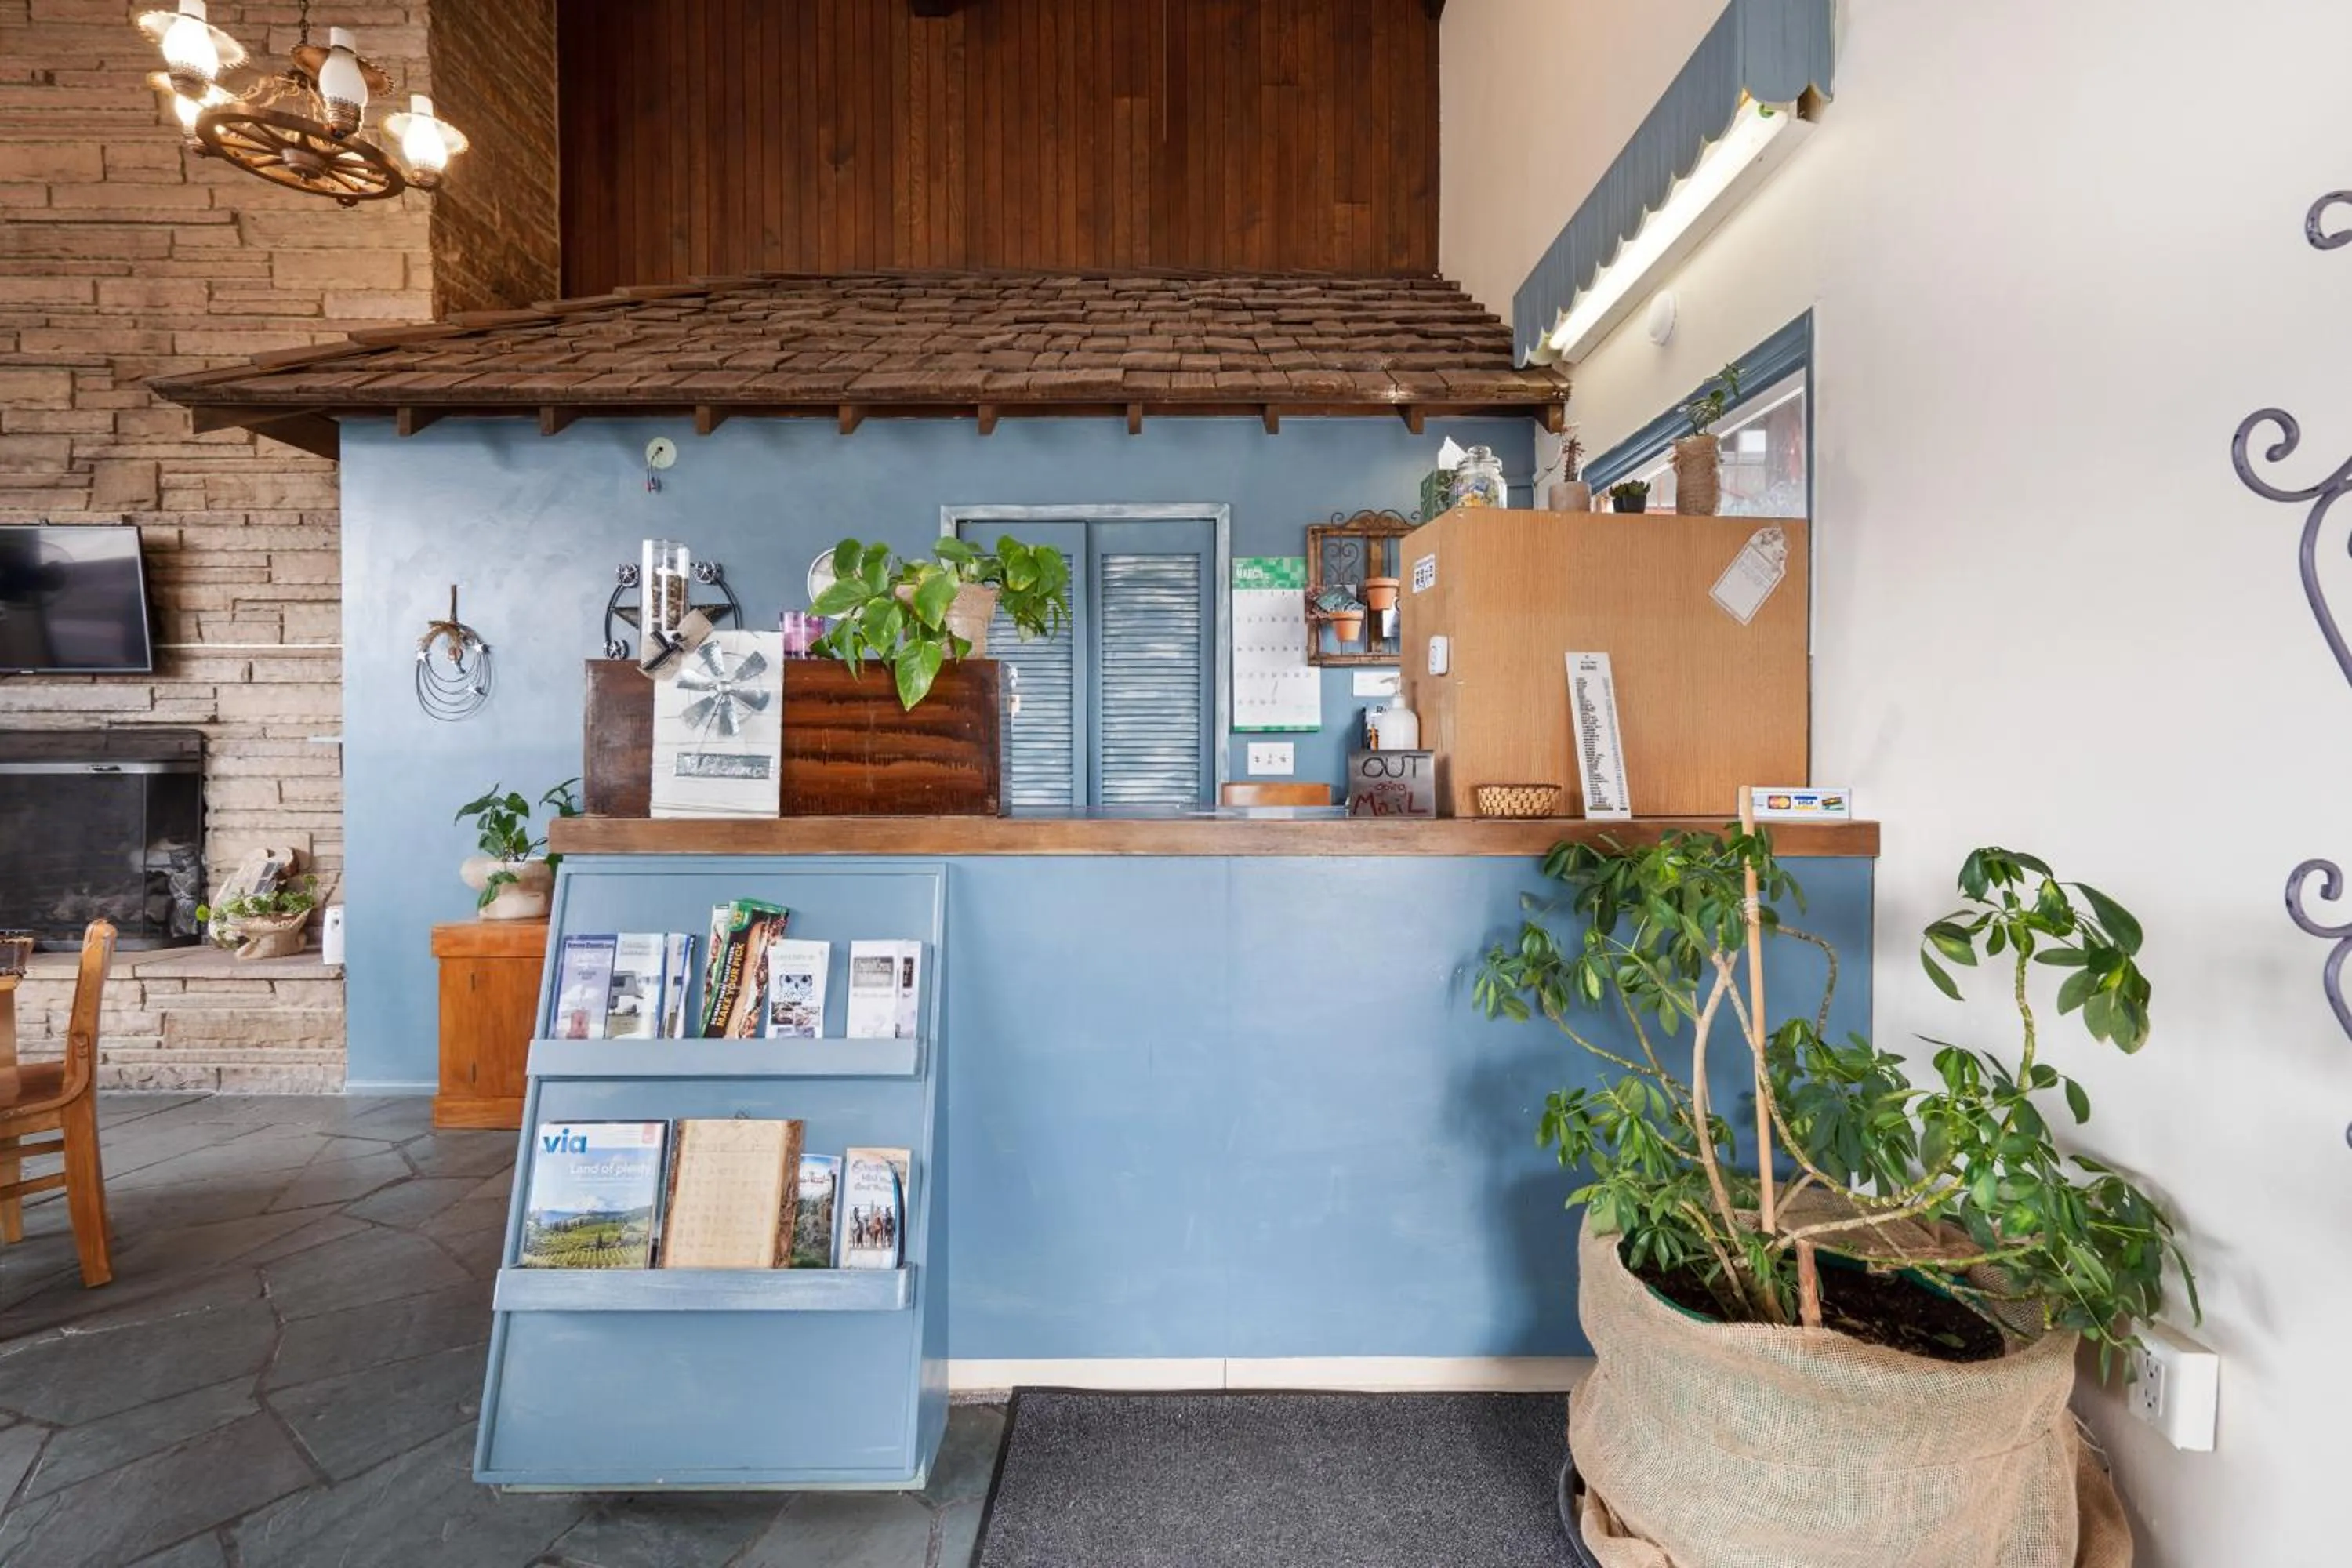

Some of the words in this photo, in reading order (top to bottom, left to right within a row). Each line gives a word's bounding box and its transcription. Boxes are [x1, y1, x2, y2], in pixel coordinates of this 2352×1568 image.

[1362, 755, 1428, 779] OUT
[717, 995, 732, 1027] MAKE
[726, 966, 739, 995] YOUR
[734, 942, 745, 965] PICK
[543, 1128, 587, 1154] via
[569, 1163, 598, 1174] Land
[601, 1163, 615, 1174] of
